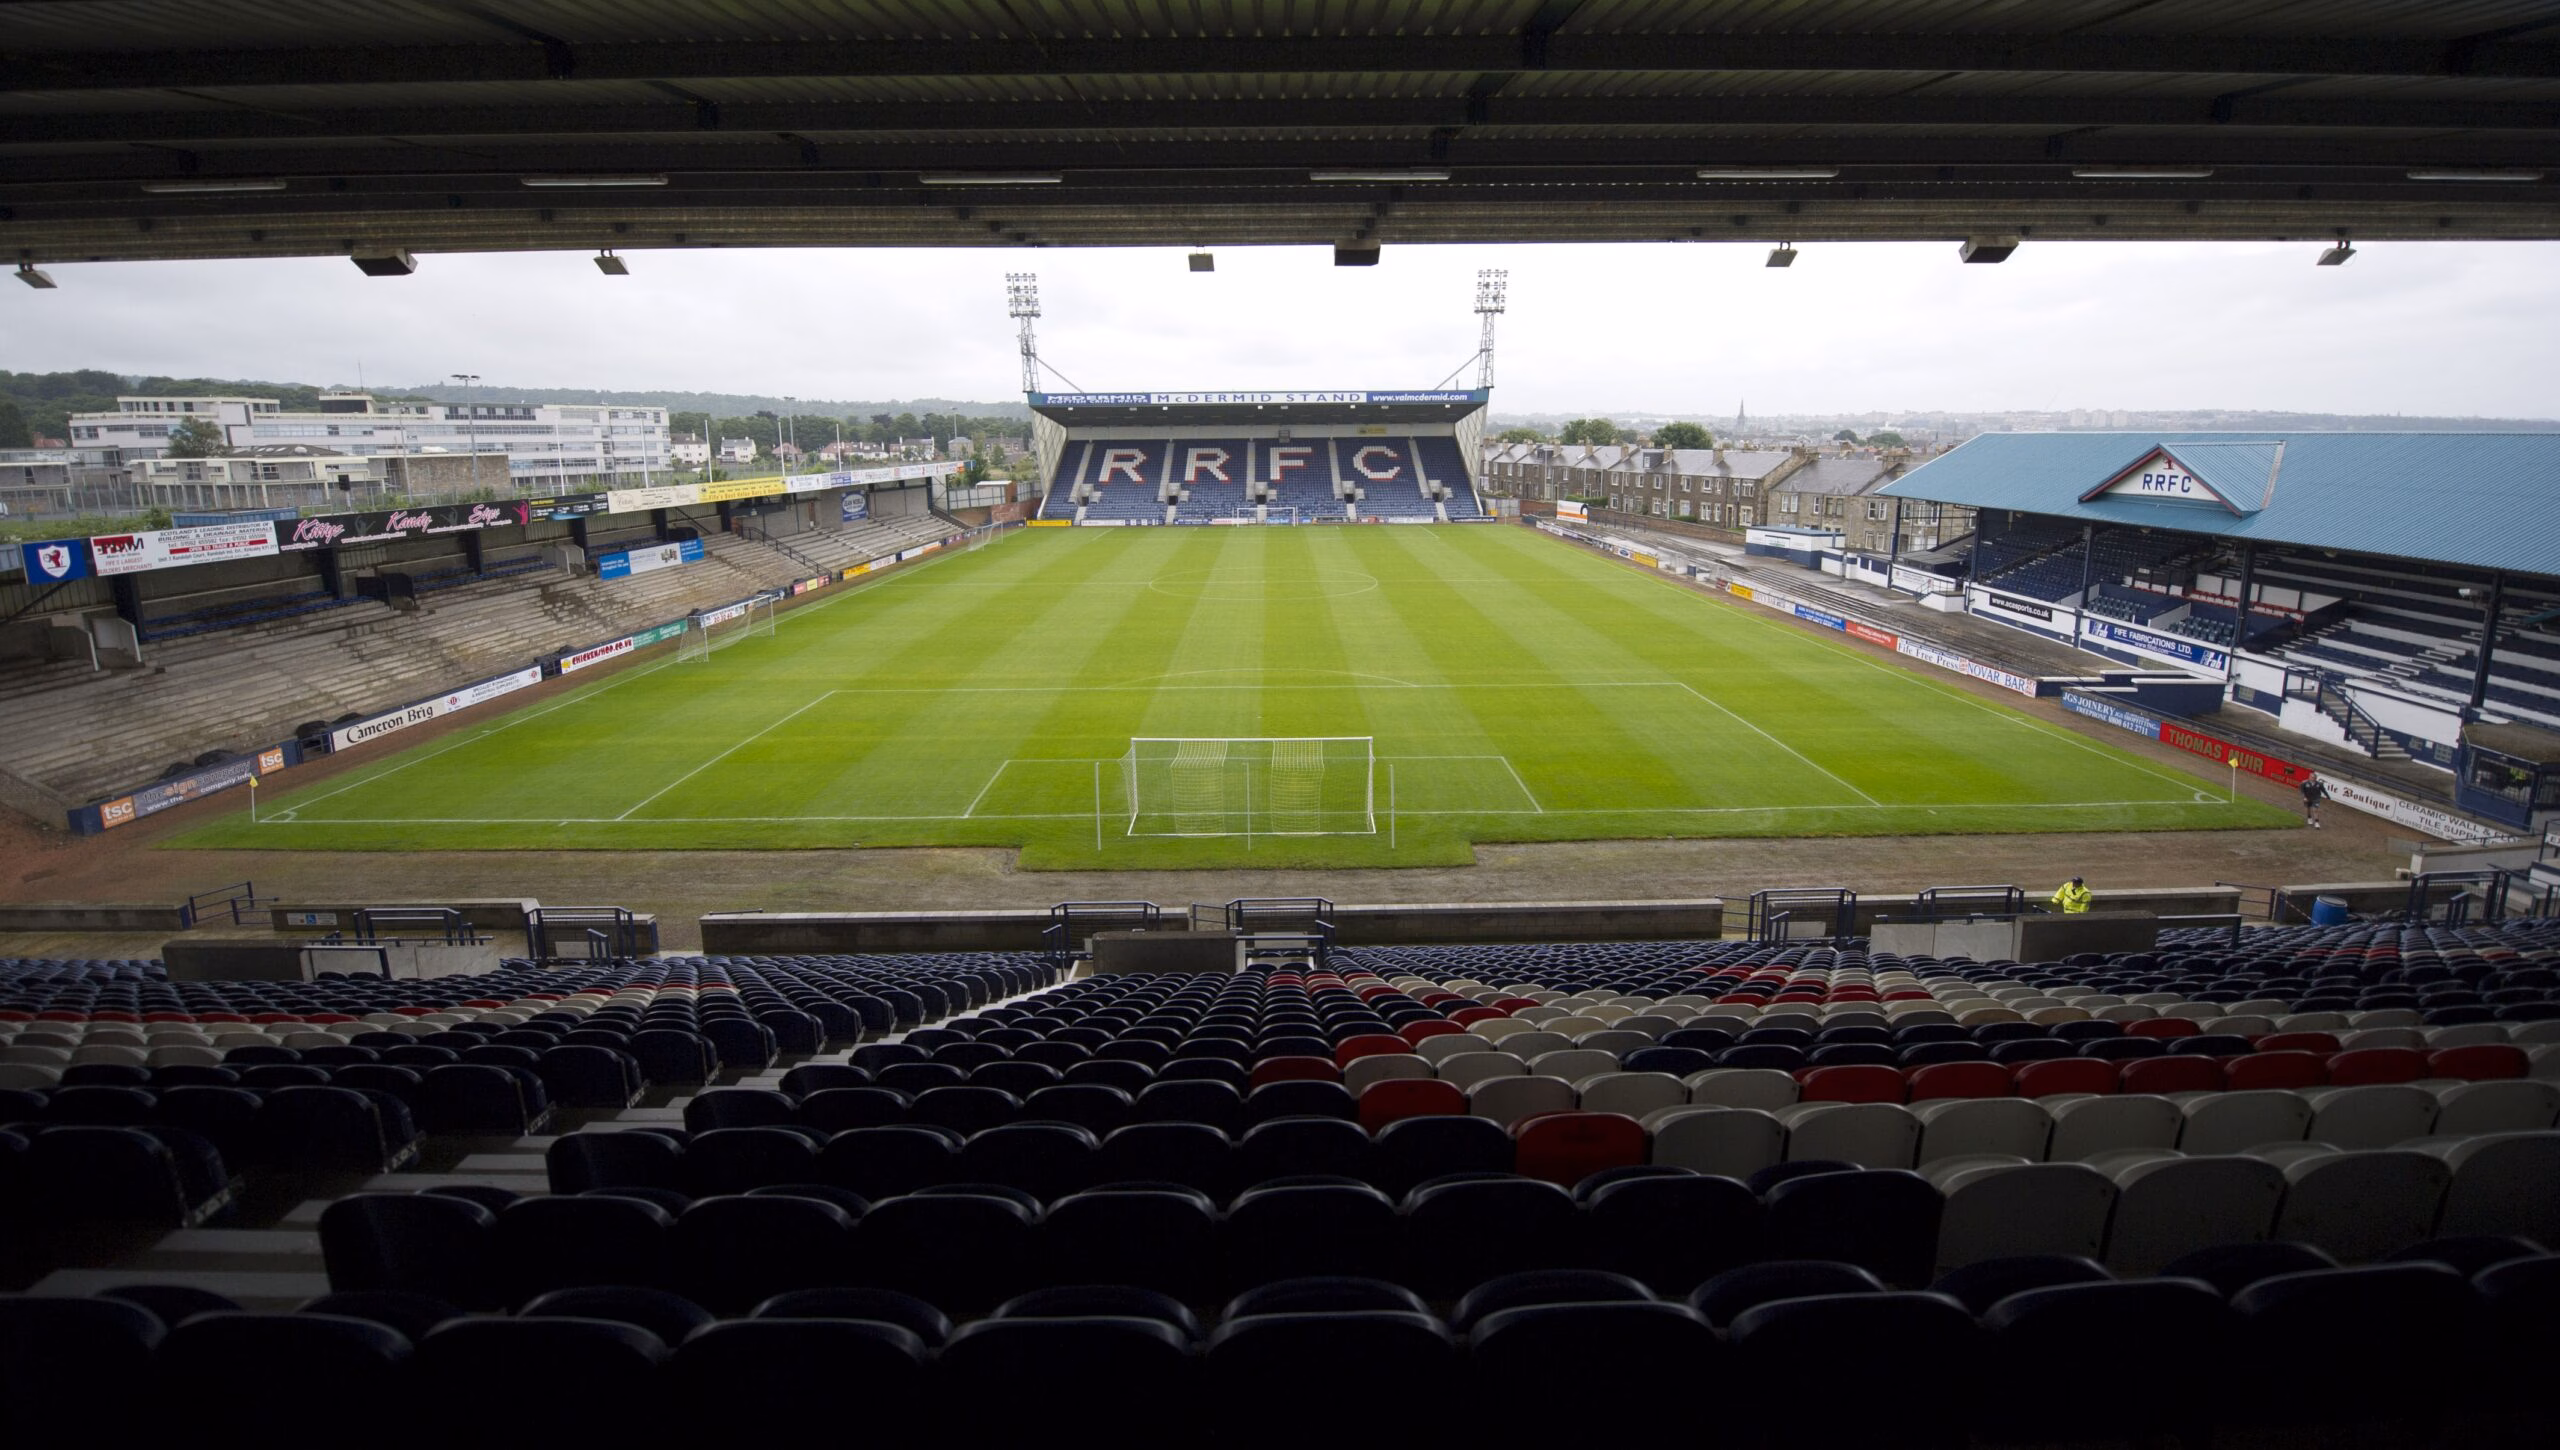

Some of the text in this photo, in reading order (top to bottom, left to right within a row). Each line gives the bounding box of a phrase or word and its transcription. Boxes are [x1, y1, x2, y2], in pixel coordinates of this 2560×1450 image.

[1157, 392, 1361, 403] McDERMID STAND
[1372, 392, 1468, 402] www.valmcdermid.com
[2142, 473, 2192, 493] RRFC
[385, 510, 433, 533] Kandy
[2113, 627, 2192, 655] FIFE FABRICATIONS LTD.
[1916, 647, 1934, 661] Free
[1937, 655, 1960, 671] Press
[1967, 661, 2026, 692] NOVAR BAR
[2075, 705, 2108, 721] FREEPHONE
[2077, 696, 2116, 716] JOINERY
[346, 705, 434, 744] Cameron Brig
[260, 751, 283, 769] tsc
[2168, 727, 2264, 774] THOMAS MUIR
[2342, 786, 2391, 811] Boutique
[103, 801, 133, 821] tsc
[2399, 800, 2447, 821] CERAMIC
[2448, 815, 2480, 833] WALL
[2482, 827, 2491, 836] &
[2419, 815, 2441, 830] TILE
